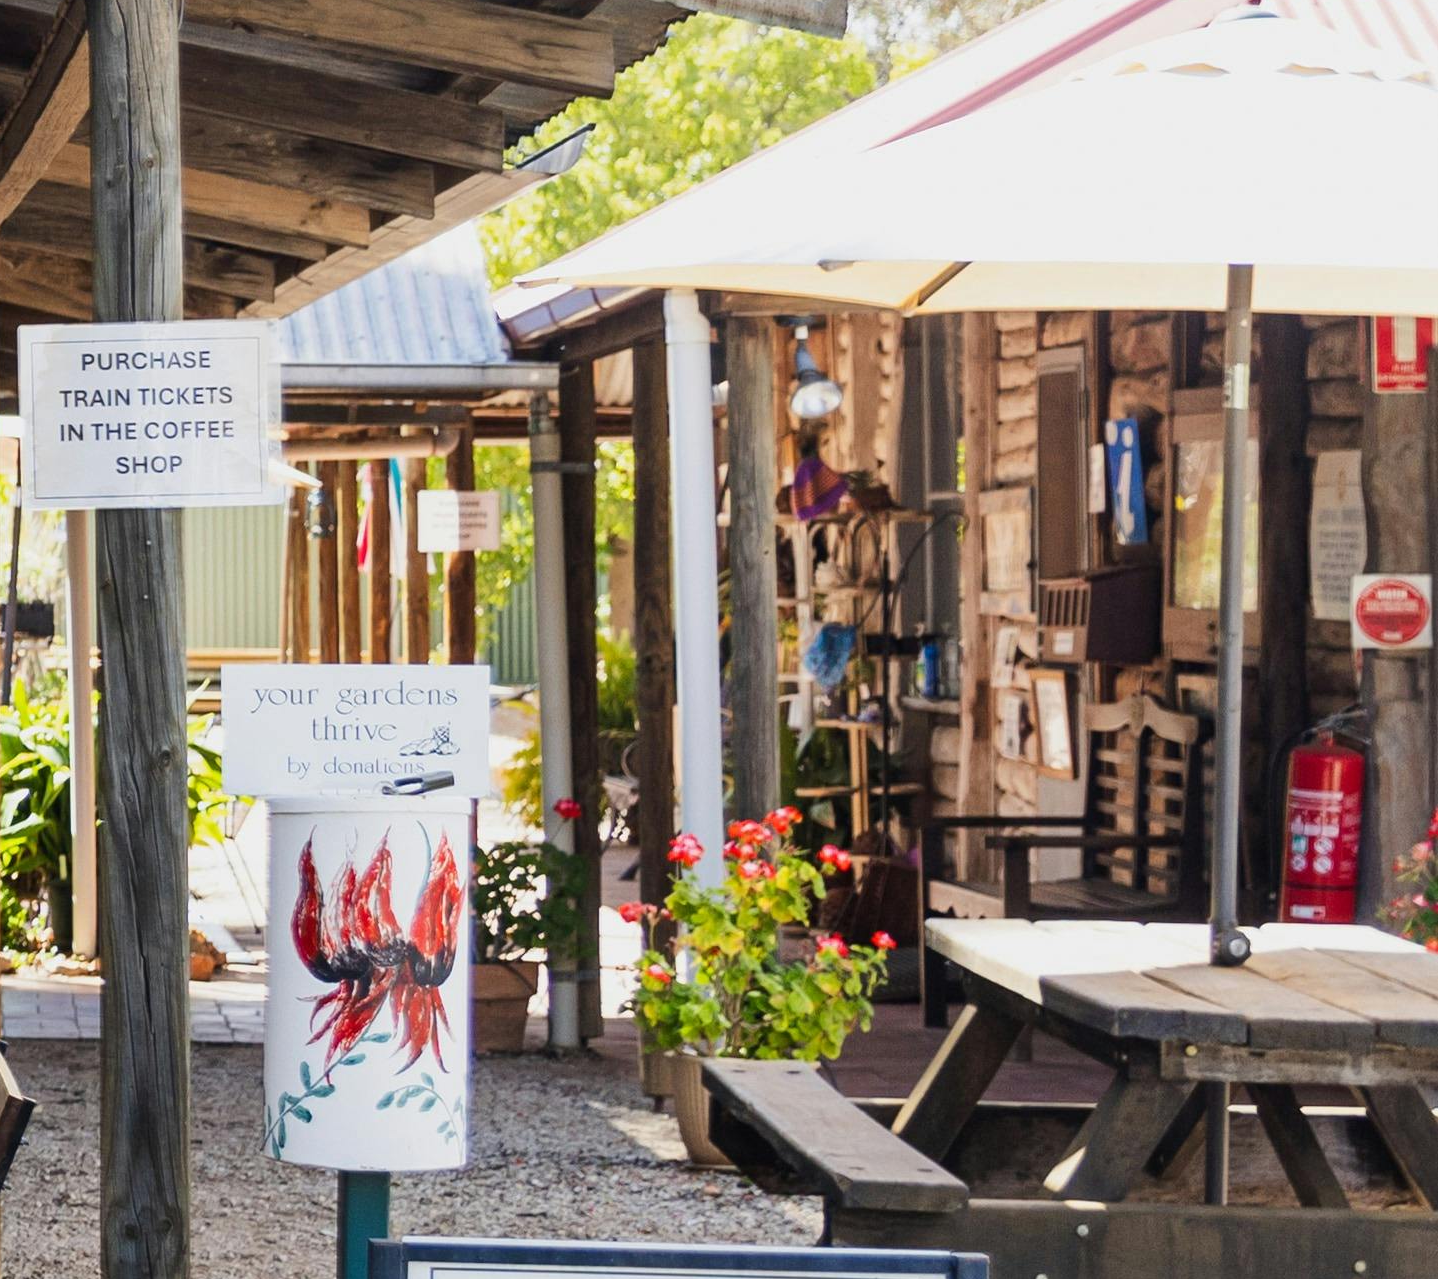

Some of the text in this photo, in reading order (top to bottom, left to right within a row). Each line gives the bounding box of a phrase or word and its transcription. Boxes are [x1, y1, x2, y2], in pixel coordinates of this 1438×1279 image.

[81, 351, 211, 371] PURCHASE
[59, 386, 233, 408] TRAIN TICKETS
[60, 420, 235, 442] IN THE COFFEE
[116, 456, 183, 474] SHOP
[251, 680, 458, 715] your gardens
[312, 716, 398, 741] thrive
[287, 756, 426, 779] by donations
